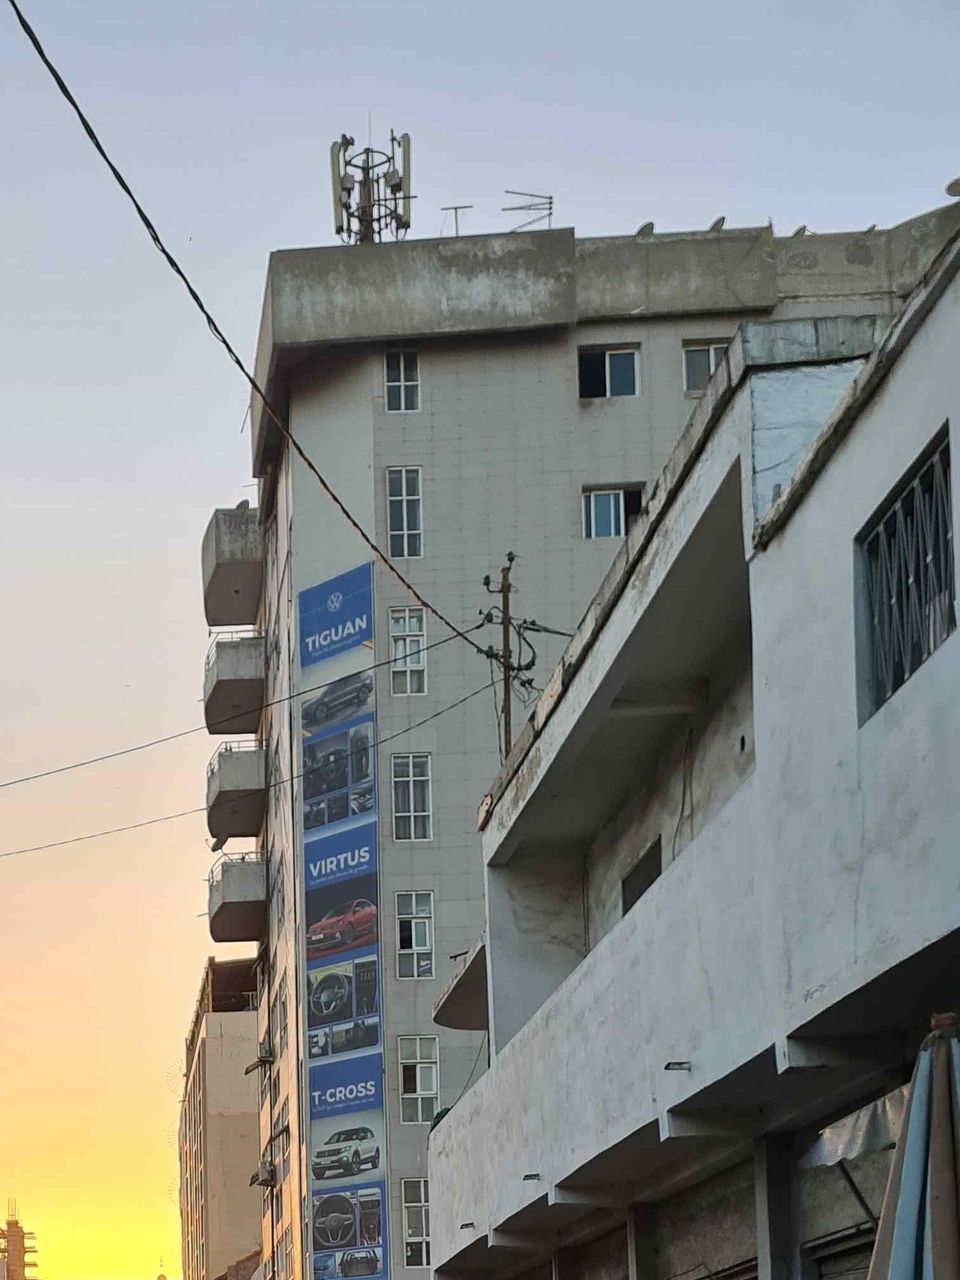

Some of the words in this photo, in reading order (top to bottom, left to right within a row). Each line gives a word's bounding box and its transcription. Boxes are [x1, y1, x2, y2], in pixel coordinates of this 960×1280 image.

[305, 614, 368, 652] TIGUAN
[309, 846, 370, 877] VIRTUS
[312, 1081, 376, 1105] T-CROSS
